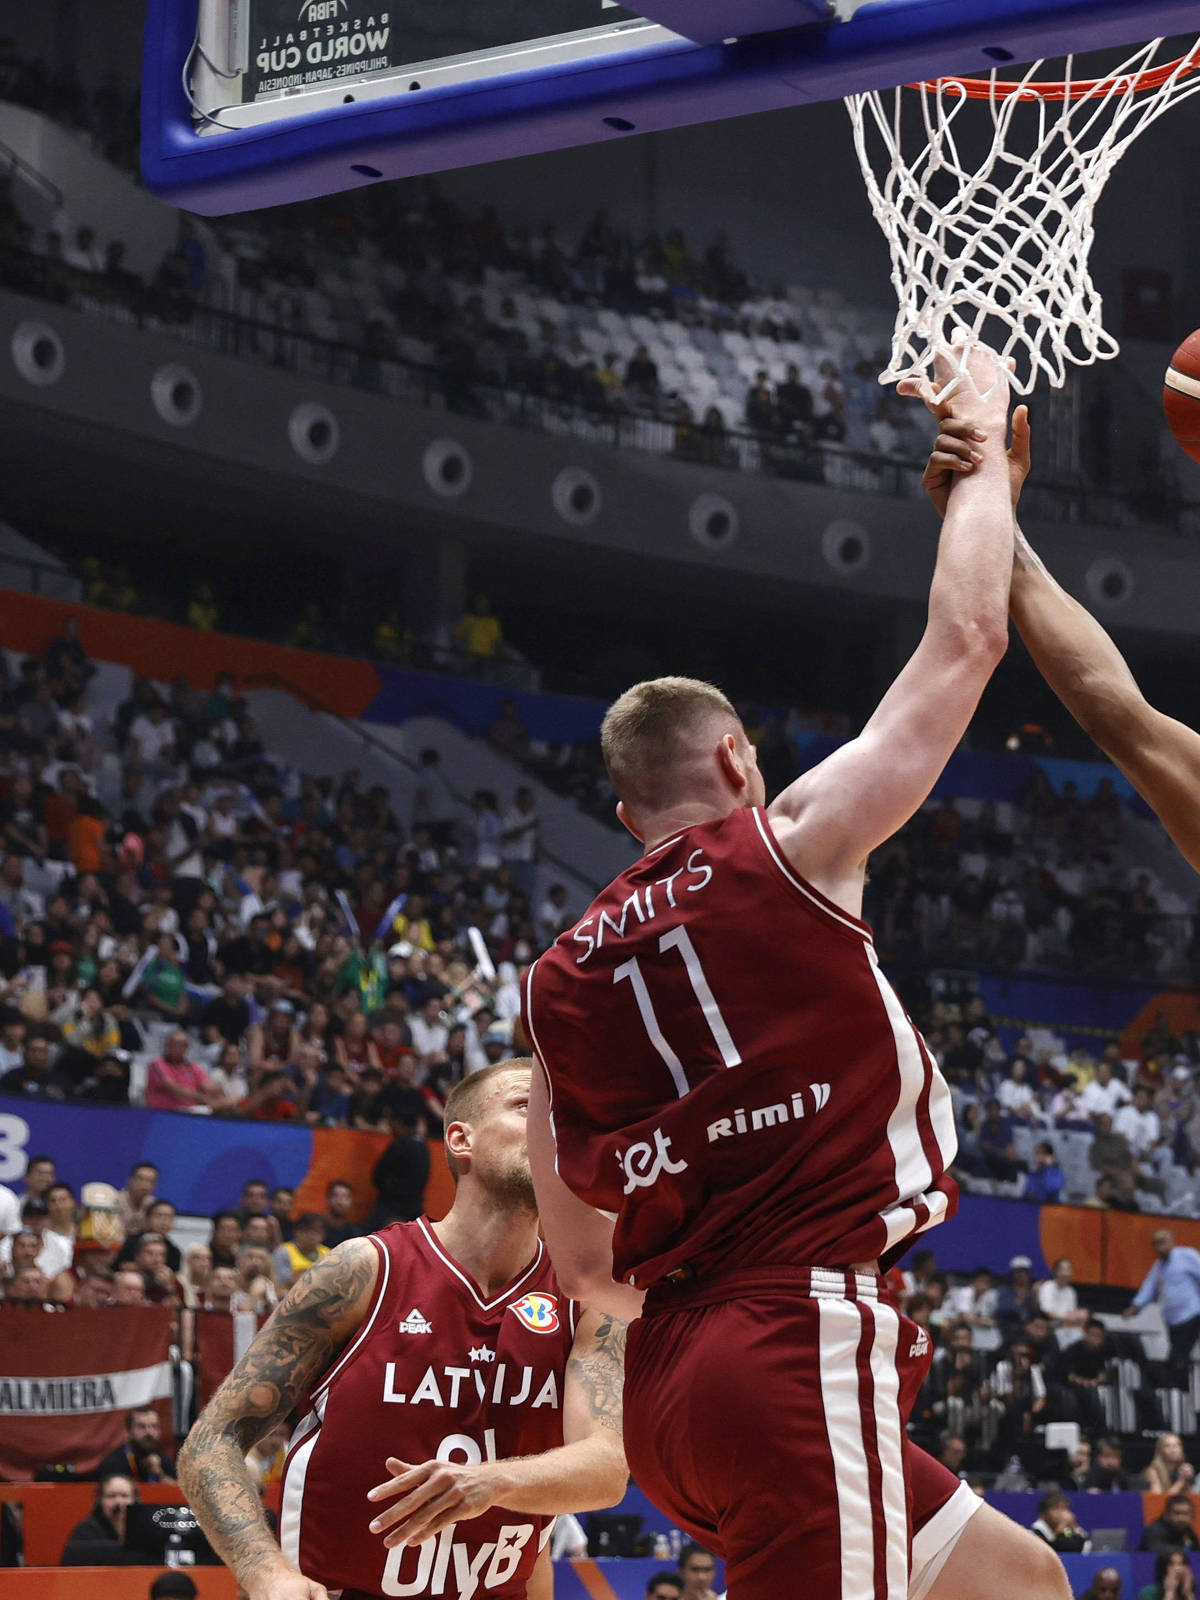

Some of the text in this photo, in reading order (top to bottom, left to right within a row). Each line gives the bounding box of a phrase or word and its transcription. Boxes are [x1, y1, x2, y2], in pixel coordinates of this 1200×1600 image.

[573, 849, 713, 963] SMITS
[613, 924, 742, 1099] 11
[399, 1321, 432, 1334] PEAK
